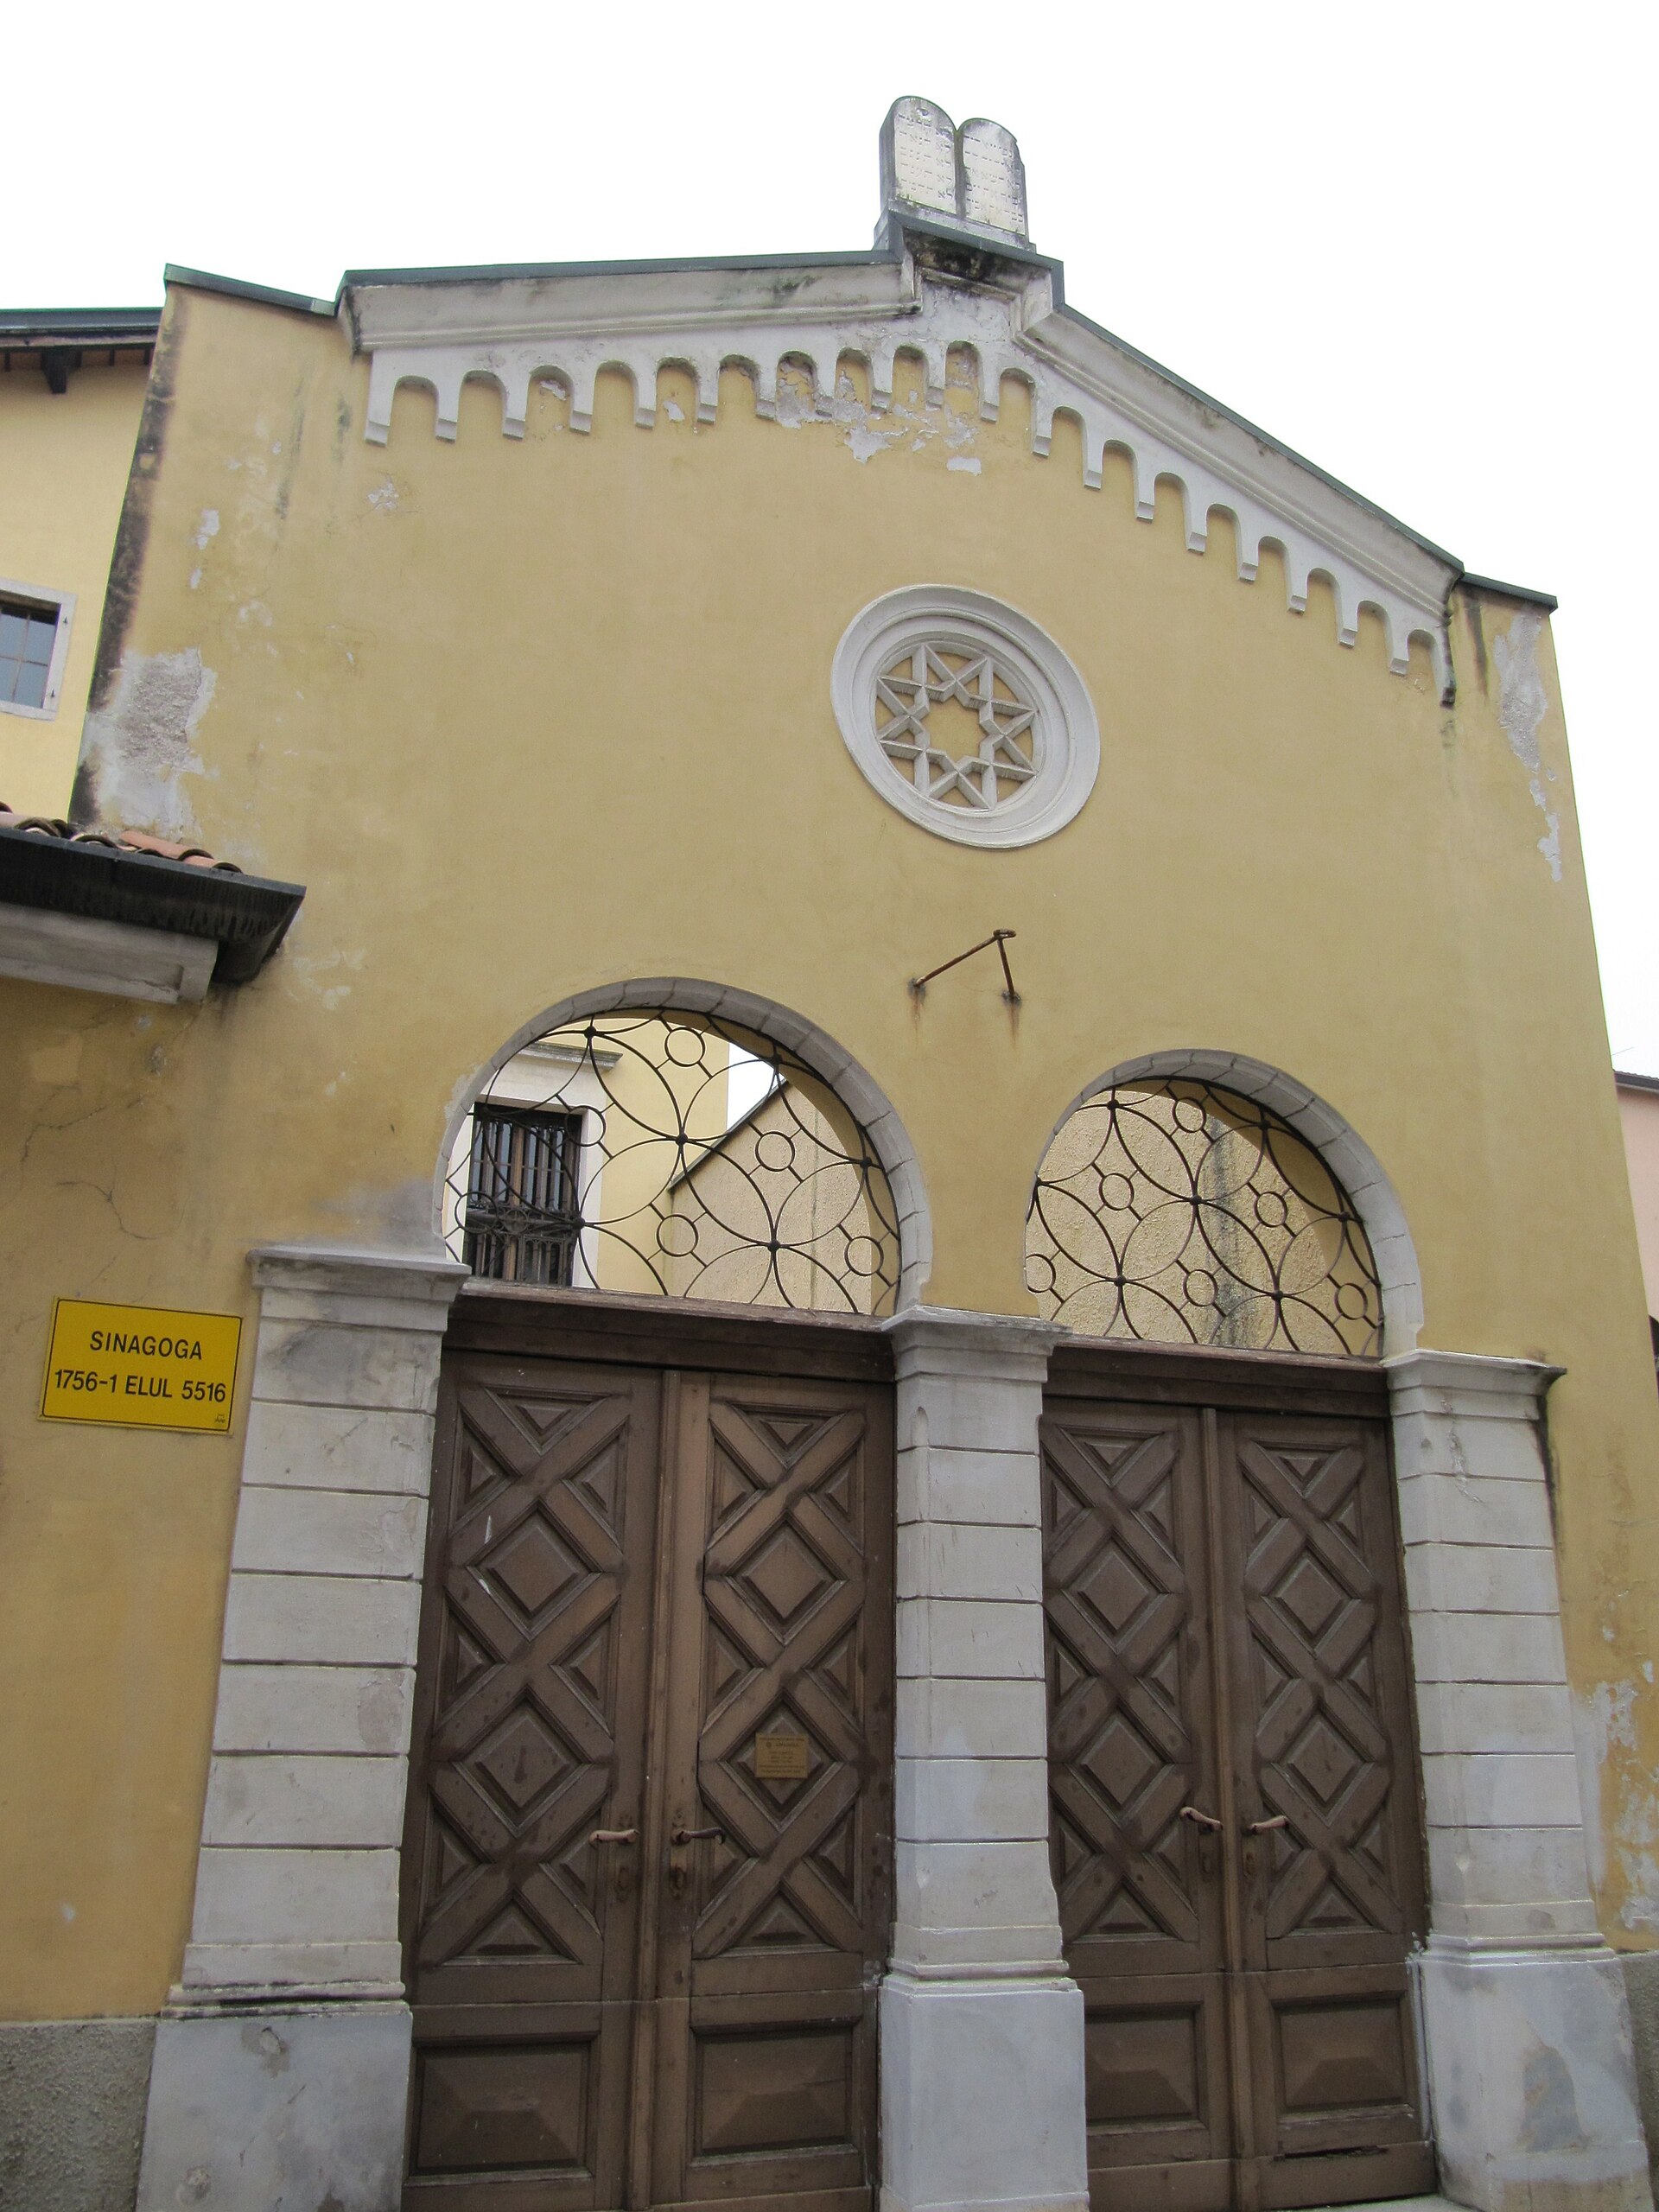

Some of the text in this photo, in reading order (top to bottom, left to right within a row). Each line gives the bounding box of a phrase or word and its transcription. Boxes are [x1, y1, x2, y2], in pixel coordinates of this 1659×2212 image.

[90, 1331, 202, 1360] SINAGOGA
[54, 1369, 226, 1403] 1756-1 ELUL 5516
